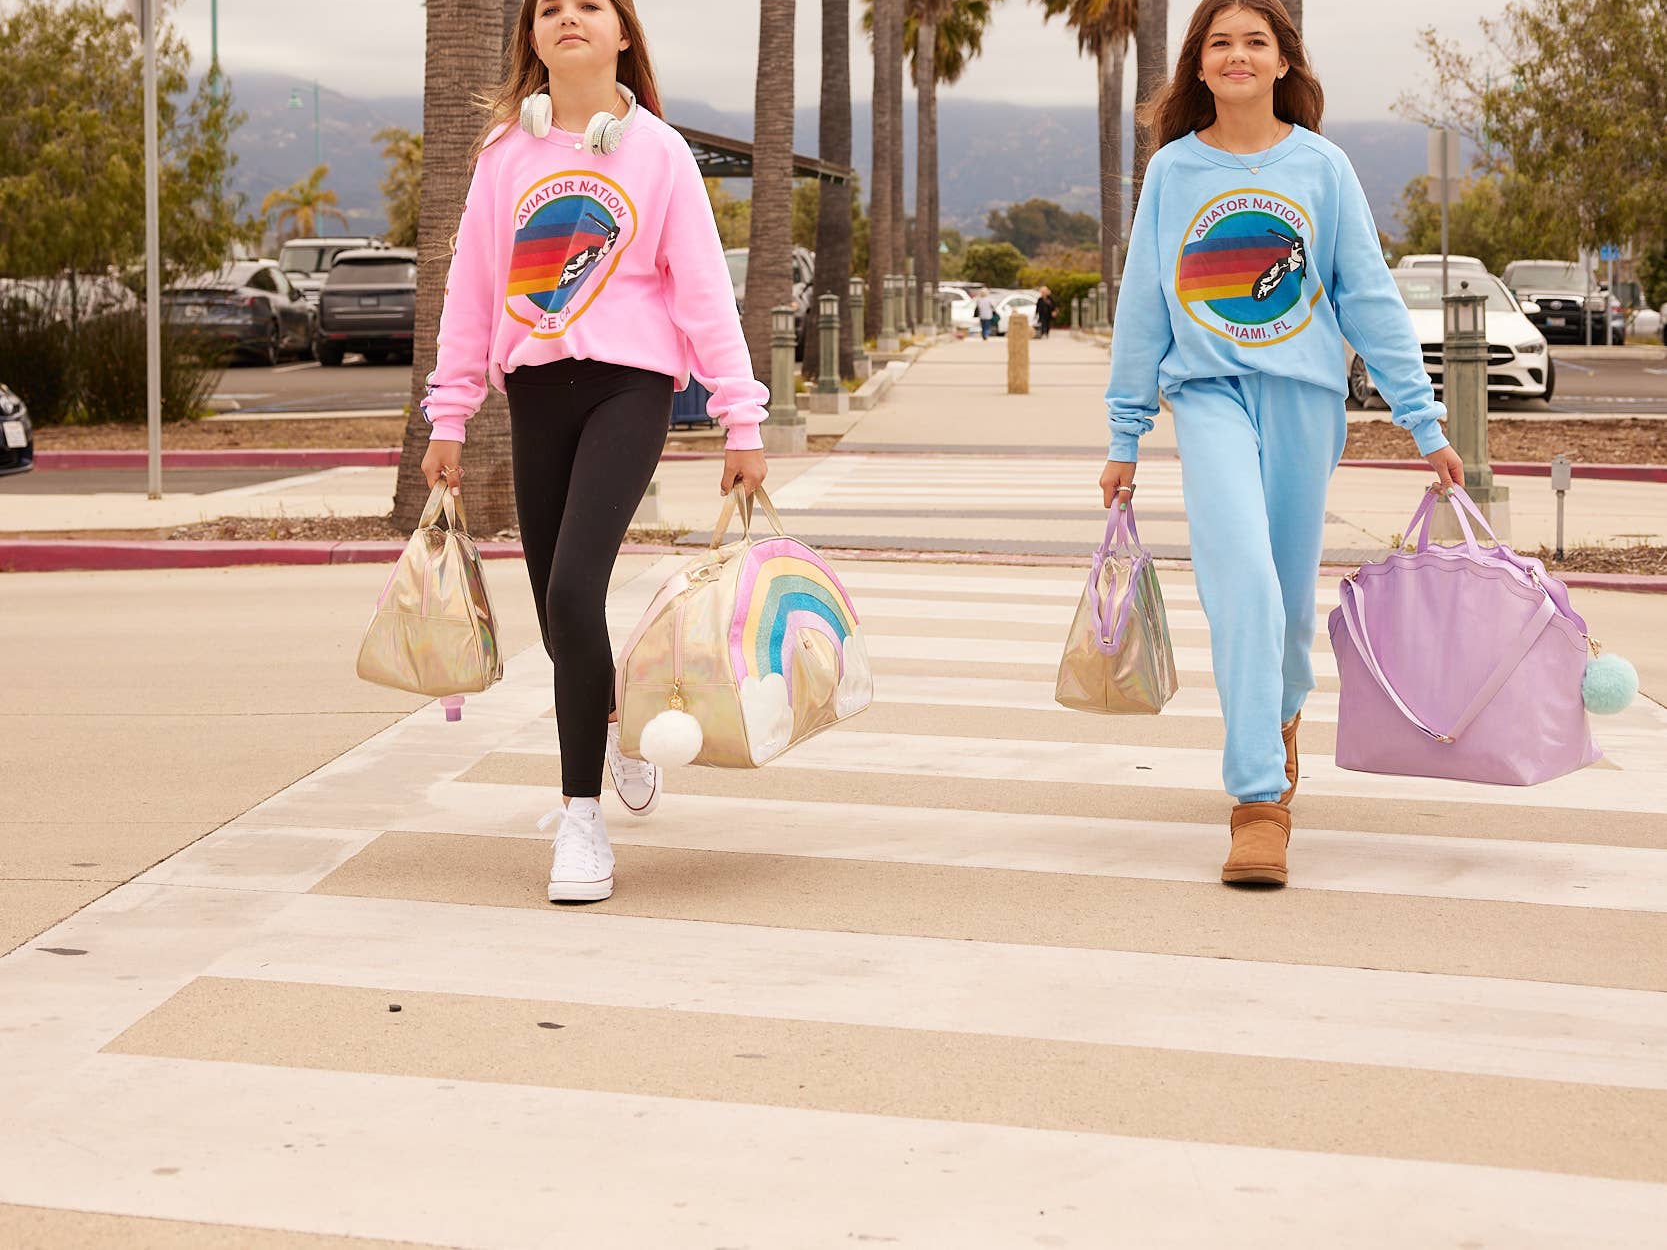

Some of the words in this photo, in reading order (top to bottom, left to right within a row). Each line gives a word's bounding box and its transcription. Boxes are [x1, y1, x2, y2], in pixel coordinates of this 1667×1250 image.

[518, 180, 575, 225] AVIATOR
[579, 180, 627, 219] NATION
[1196, 198, 1248, 238] AVIATOR
[1253, 197, 1304, 230] NATION
[1225, 323, 1271, 339] MIAMI,
[1273, 320, 1292, 335] FL
